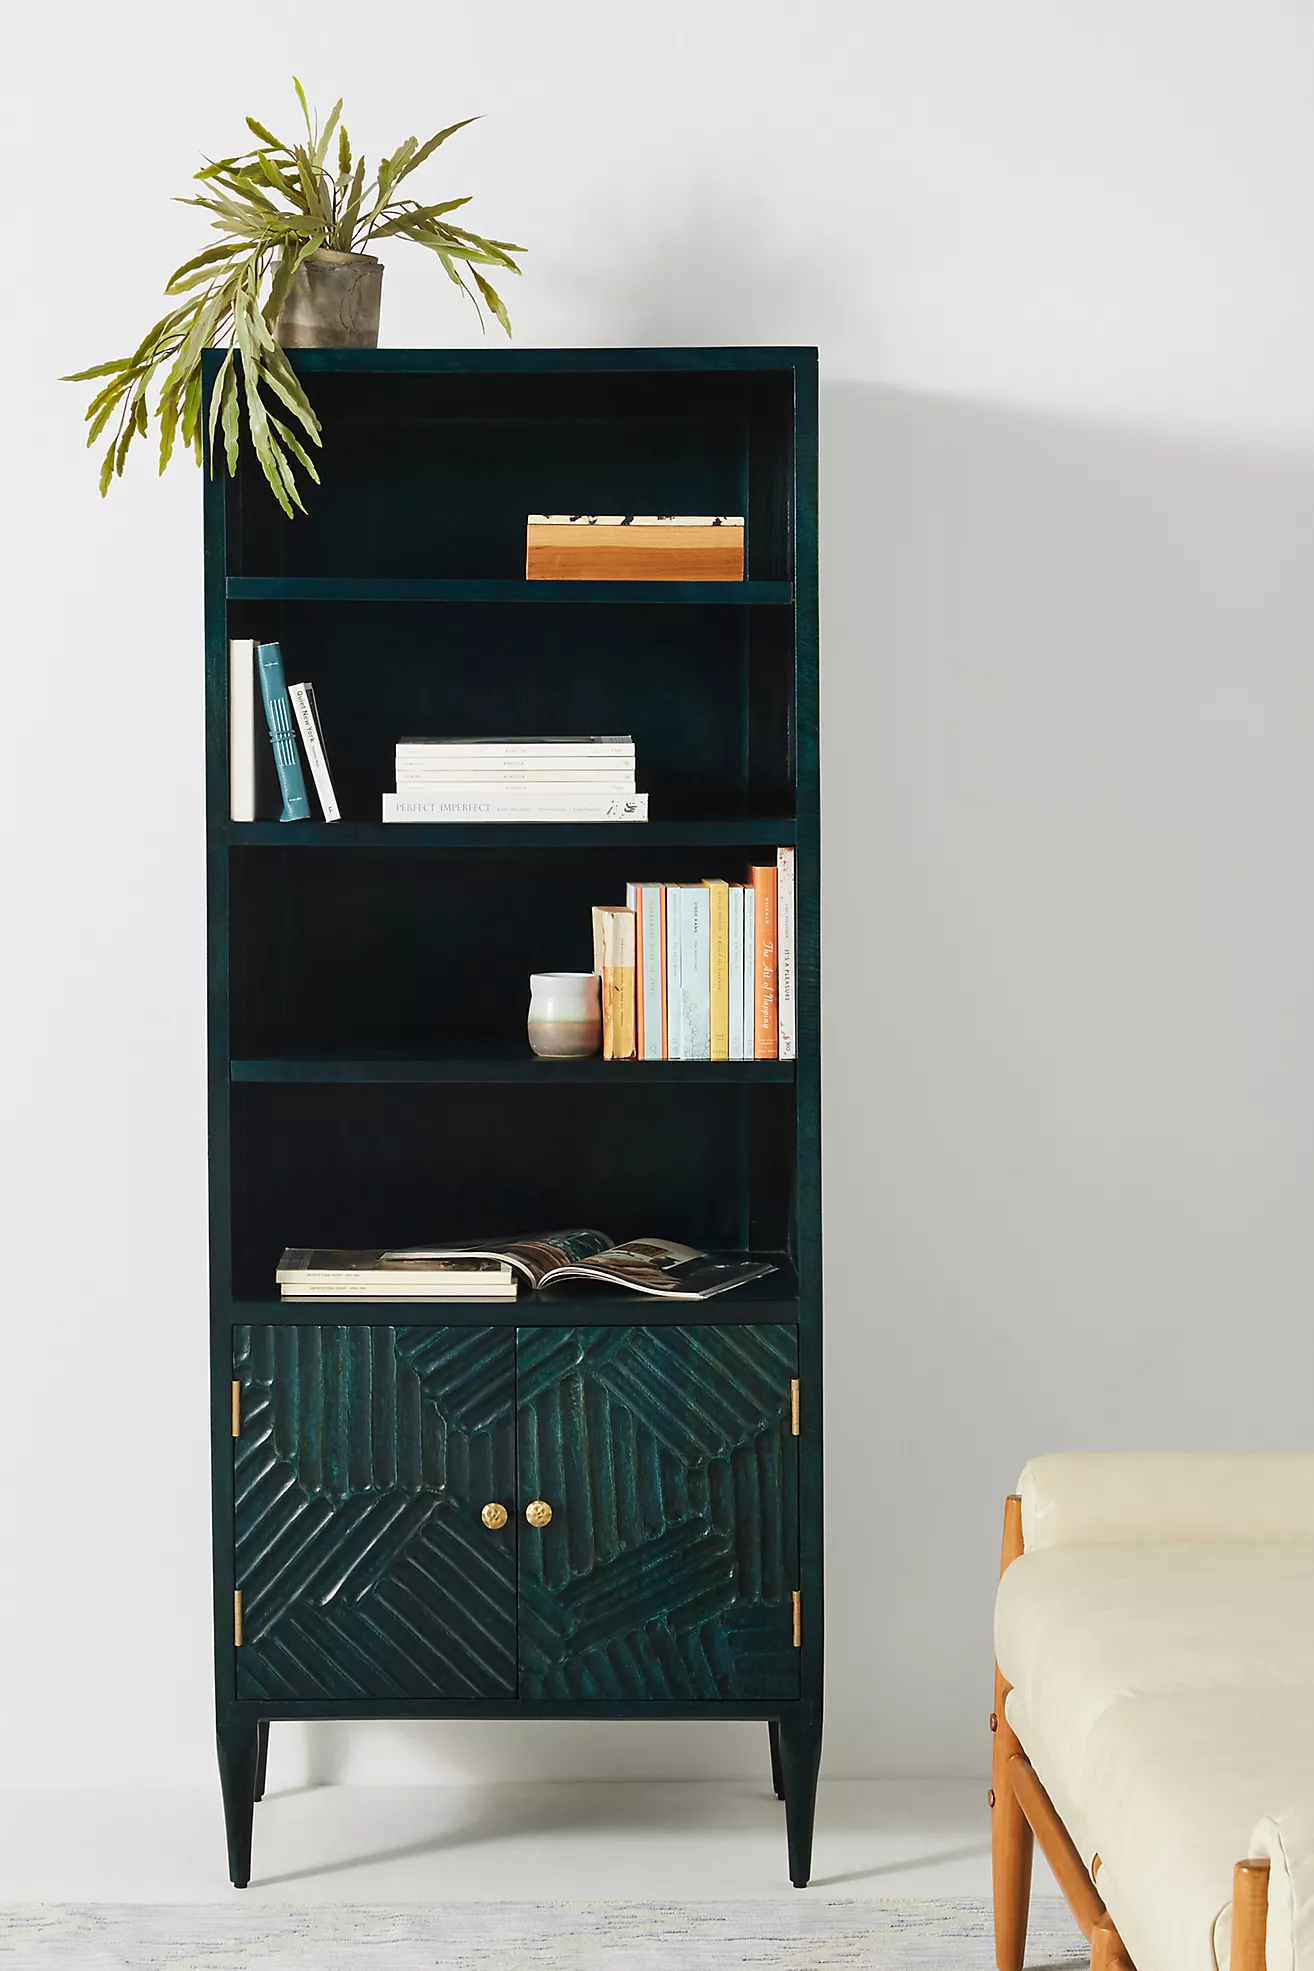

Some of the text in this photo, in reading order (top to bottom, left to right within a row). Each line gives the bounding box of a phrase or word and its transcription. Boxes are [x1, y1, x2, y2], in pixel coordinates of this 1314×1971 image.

[296, 690, 316, 744] Quiet New York
[396, 803, 435, 812] PERFECT
[440, 803, 491, 812] IMPERFECT
[762, 940, 774, 958] The
[762, 961, 774, 979] Art
[761, 981, 774, 991] of
[761, 993, 774, 1029] Napping
